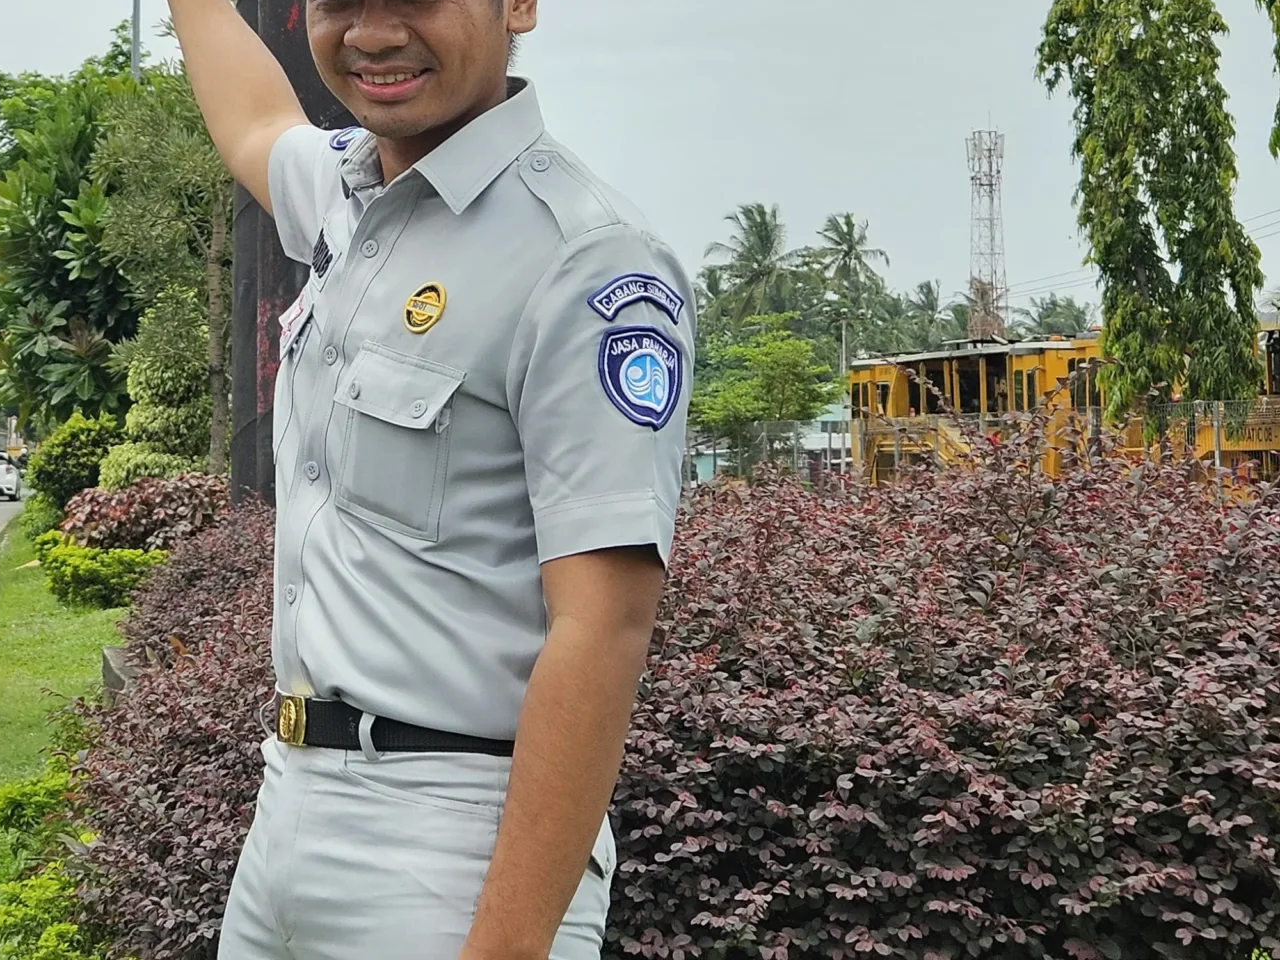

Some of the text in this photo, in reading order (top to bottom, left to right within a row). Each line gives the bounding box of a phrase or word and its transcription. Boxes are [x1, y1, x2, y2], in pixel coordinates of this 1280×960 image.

[602, 282, 676, 312] CABANG SUMBAR
[610, 337, 675, 370] JASA RAHARJA
